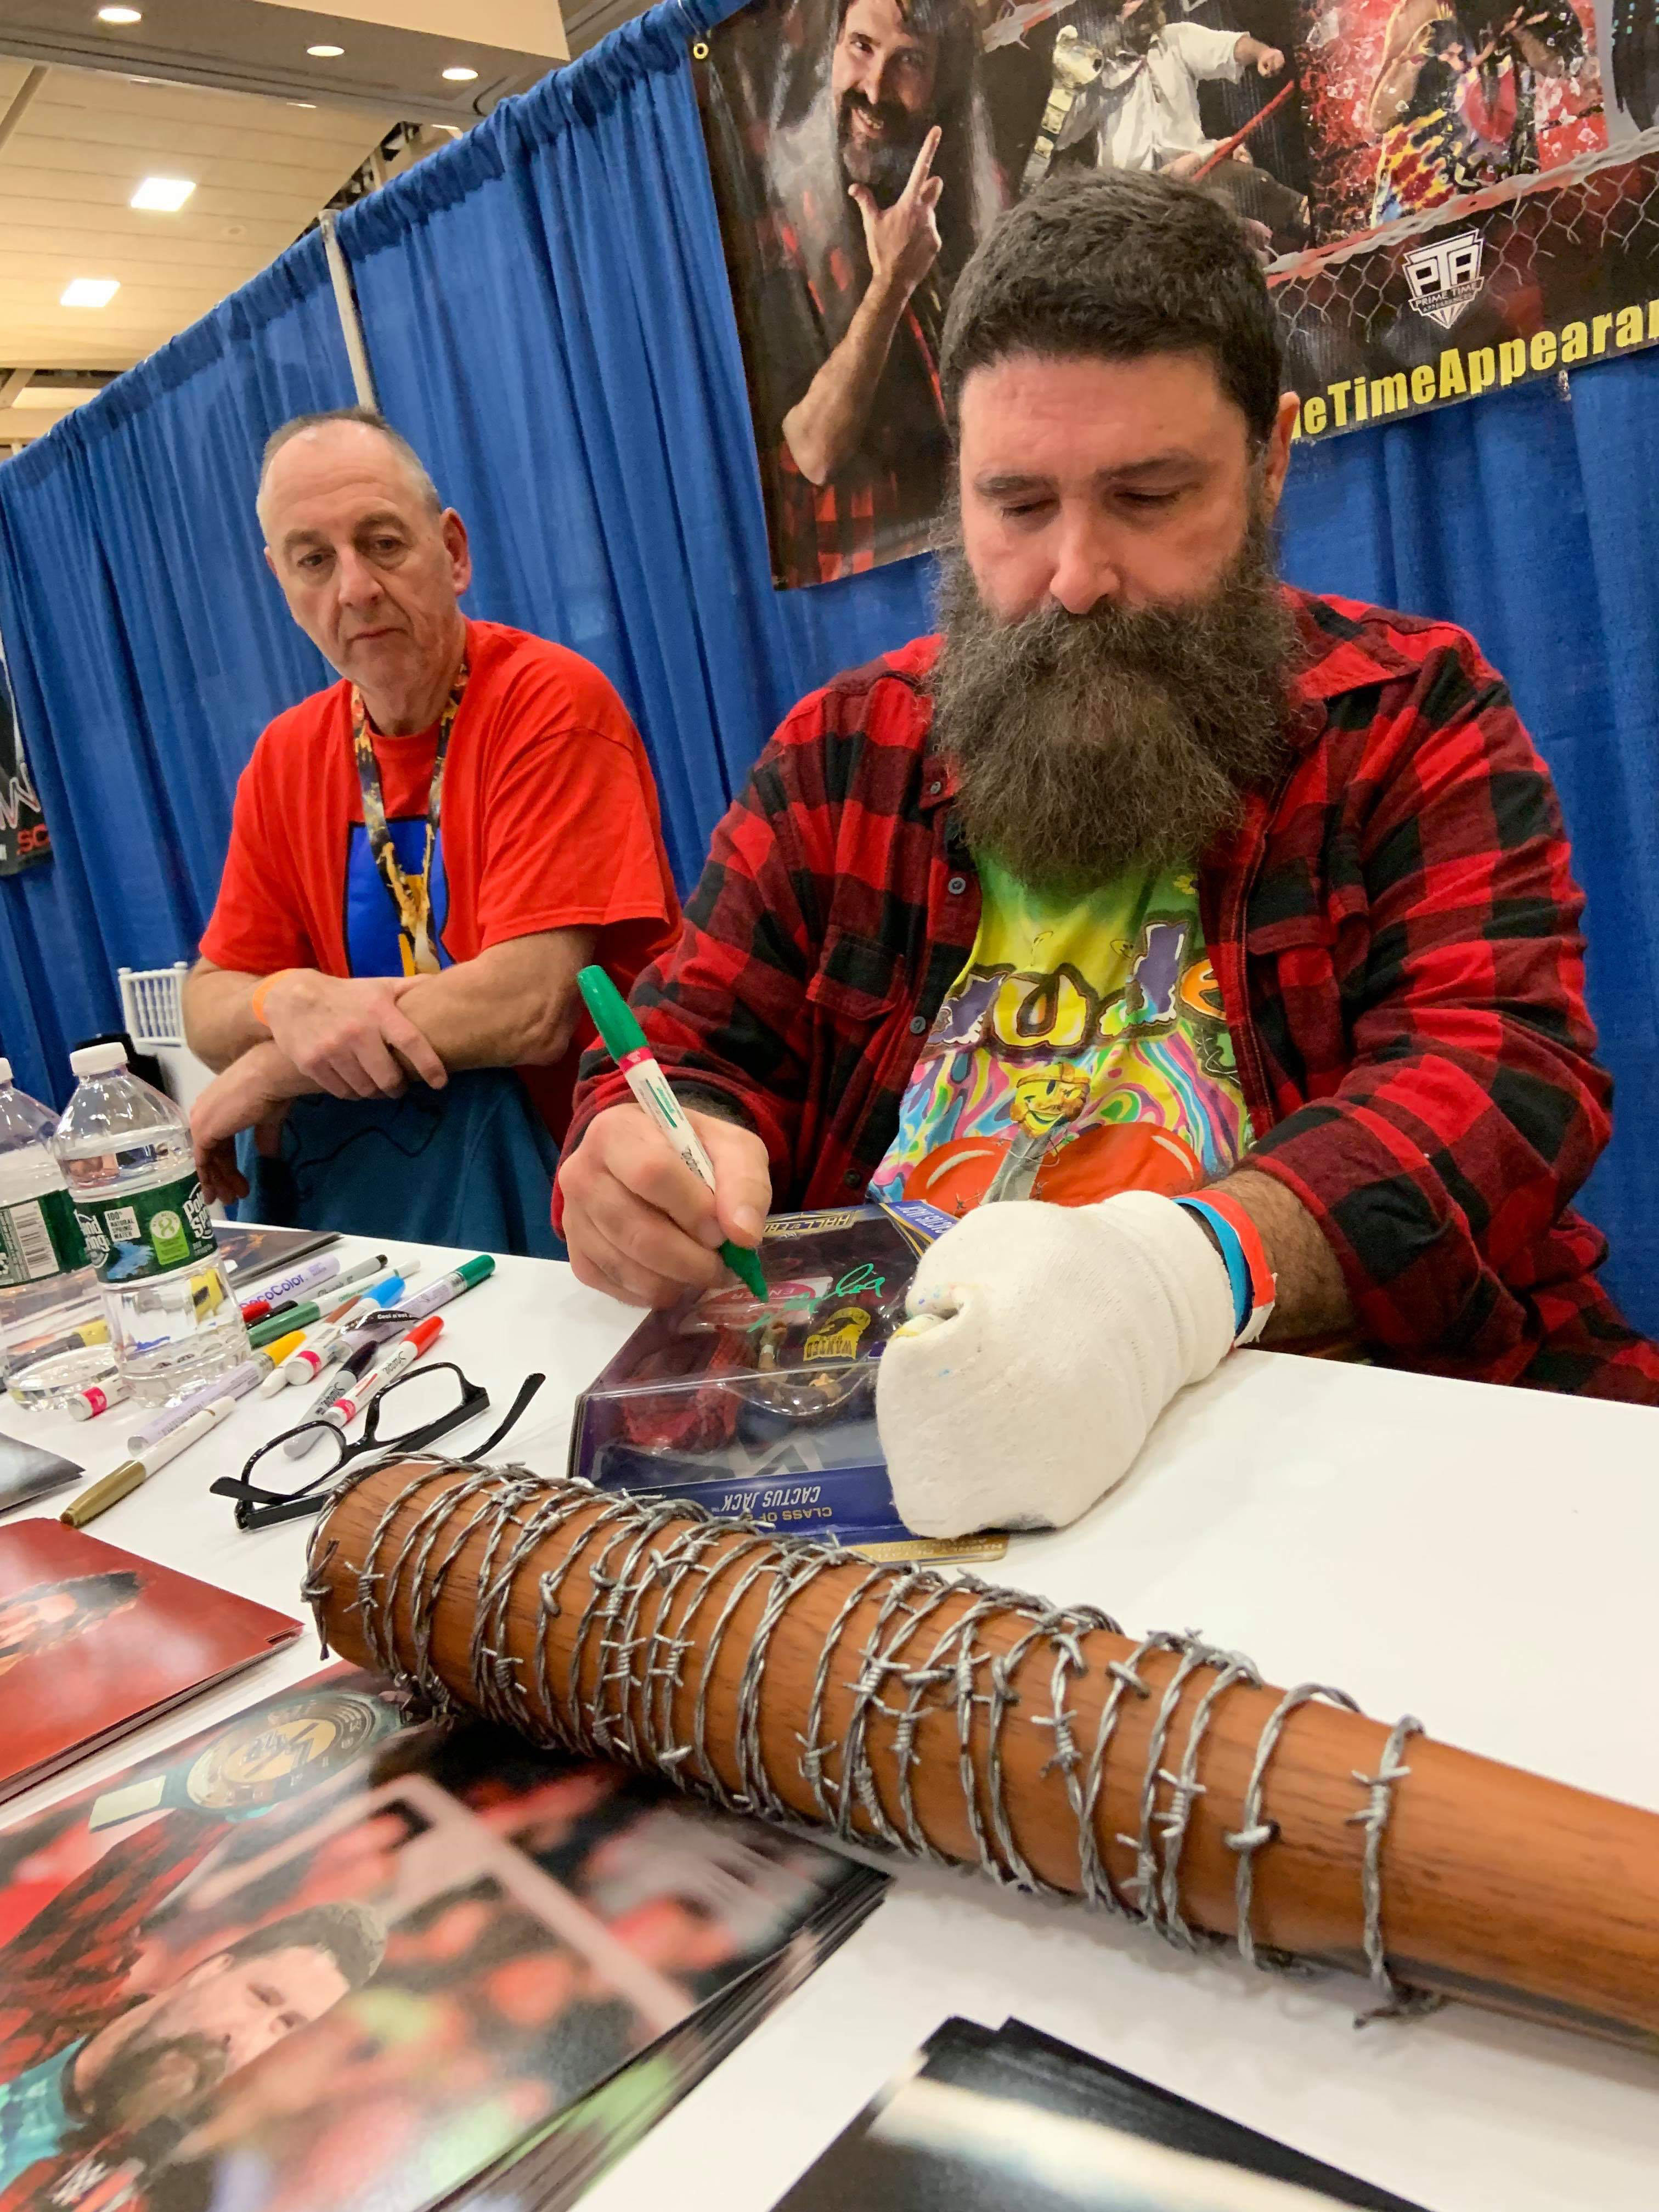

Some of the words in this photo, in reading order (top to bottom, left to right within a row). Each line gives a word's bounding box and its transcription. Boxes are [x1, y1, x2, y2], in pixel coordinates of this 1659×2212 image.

[1291, 299, 1659, 439] eTimeAppeara
[804, 1214, 850, 1230] HALL
[731, 1287, 796, 1300] ENER
[720, 1492, 760, 1512] JACK
[762, 1486, 821, 1508] CACTUS
[782, 1507, 832, 1521] CLASS
